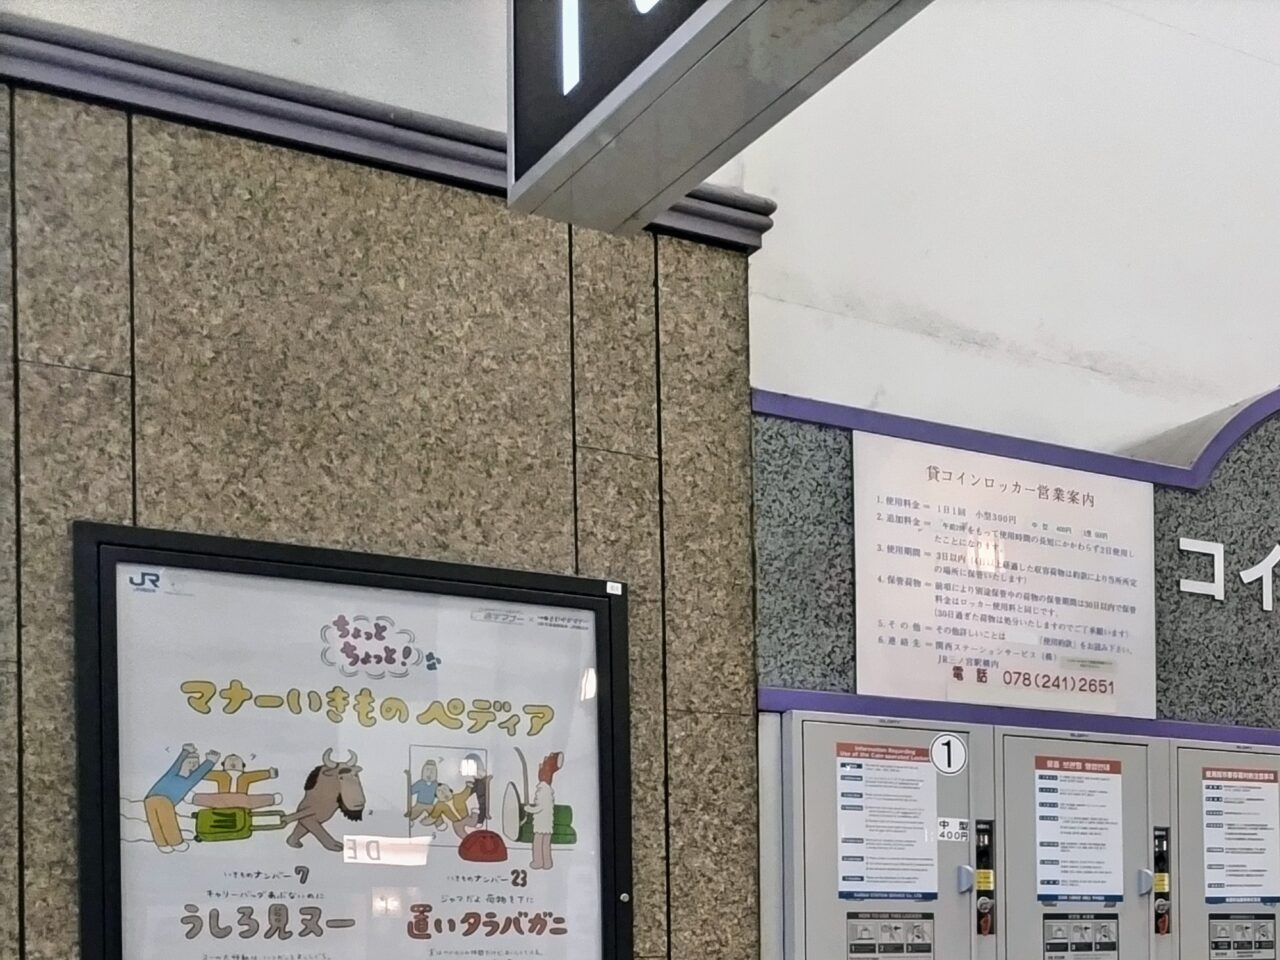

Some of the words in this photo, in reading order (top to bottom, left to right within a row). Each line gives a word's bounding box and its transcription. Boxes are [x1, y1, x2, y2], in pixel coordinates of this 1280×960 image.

[927, 465, 1095, 508] 貸コインロッカー営業案内
[129, 571, 160, 588] JR
[333, 615, 386, 641] ちょっと
[953, 666, 988, 683] 電話
[1003, 670, 1115, 695] 078(241)2651
[939, 831, 968, 840] 400円
[294, 866, 310, 884] 7
[511, 869, 528, 887] 23
[180, 904, 355, 940] うしろ見ヌー
[407, 904, 568, 940] 置いタラバガニ
